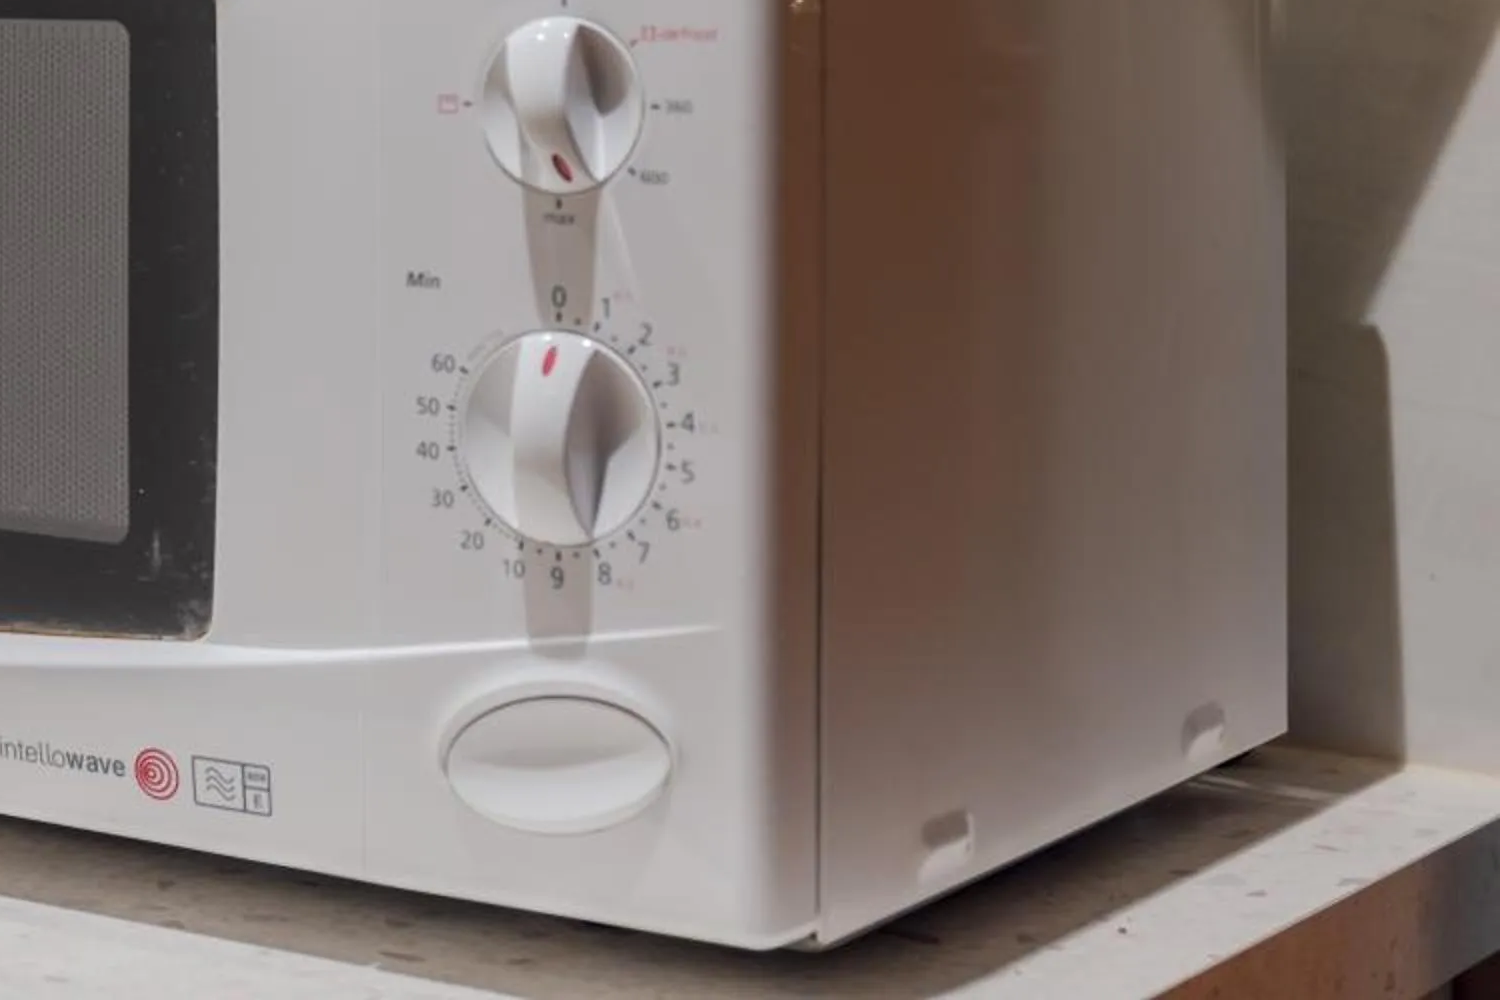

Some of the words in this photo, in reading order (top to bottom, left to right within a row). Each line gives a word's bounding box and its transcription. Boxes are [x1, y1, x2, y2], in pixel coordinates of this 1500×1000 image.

[545, 213, 575, 226] max
[405, 270, 441, 289] Min
[551, 284, 567, 309] 0
[601, 297, 610, 319] 1
[638, 322, 652, 346] 2
[431, 353, 456, 374] 60
[666, 362, 680, 386] 3
[415, 396, 441, 417] 50
[680, 411, 695, 433] 4
[416, 440, 440, 460] 40
[680, 459, 696, 484] 5
[431, 488, 455, 508] 30
[665, 508, 680, 532] 6
[460, 529, 485, 551] 20
[637, 541, 651, 565] 7
[503, 559, 526, 579] 10
[550, 566, 565, 590] 9
[597, 561, 613, 585] 8
